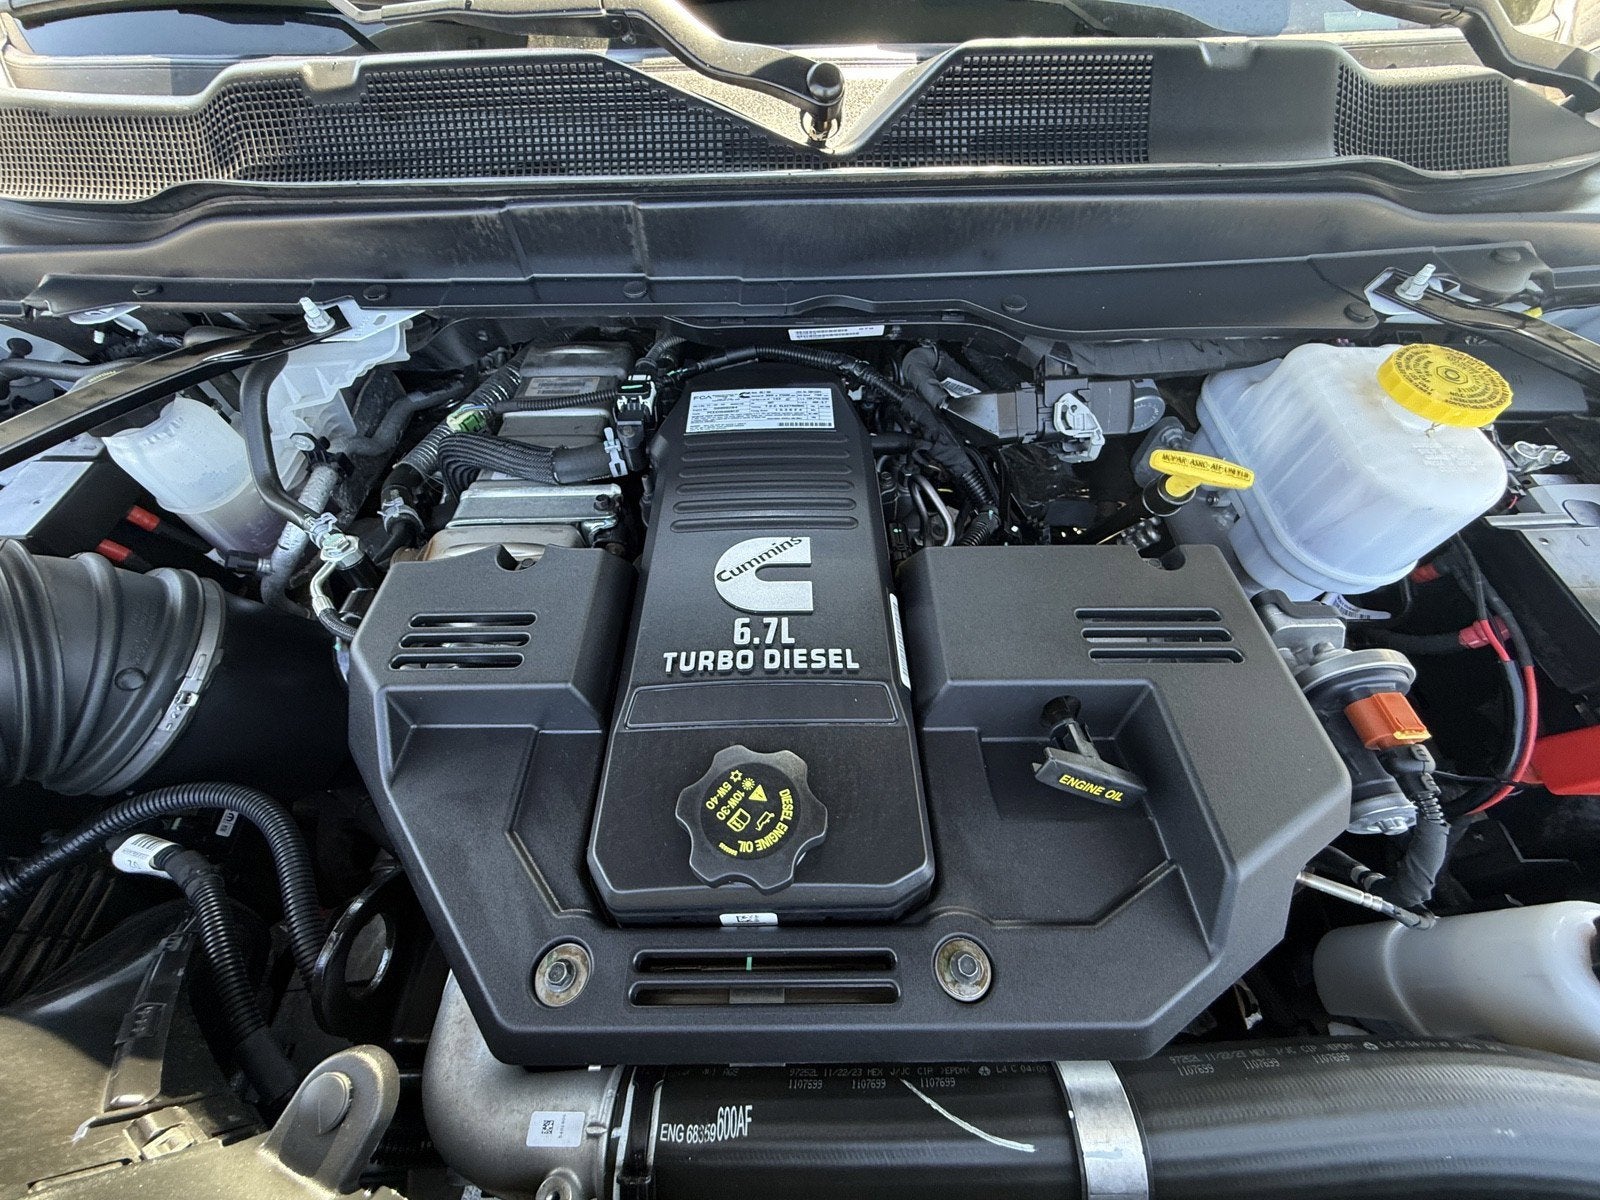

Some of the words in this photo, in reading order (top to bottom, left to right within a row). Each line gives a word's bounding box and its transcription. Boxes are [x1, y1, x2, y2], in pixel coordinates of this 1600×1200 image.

[715, 537, 803, 583] Cummins
[733, 616, 796, 646] 6.7L
[662, 649, 755, 674] TURBO
[763, 648, 860, 672] DIESEL
[705, 781, 733, 810] 5W-40
[1058, 773, 1106, 796] ENGINE
[1104, 789, 1124, 802] OIL
[716, 789, 746, 821] 10W-30
[778, 788, 794, 821] DIESEL
[737, 839, 754, 853] OIL
[754, 821, 789, 852] ENGINE
[788, 1079, 823, 1090] 1107699
[824, 1067, 863, 1077] 11/22/23
[851, 1078, 886, 1090] 1107699
[920, 1077, 956, 1088] 1107699
[660, 1122, 685, 1143] ENG
